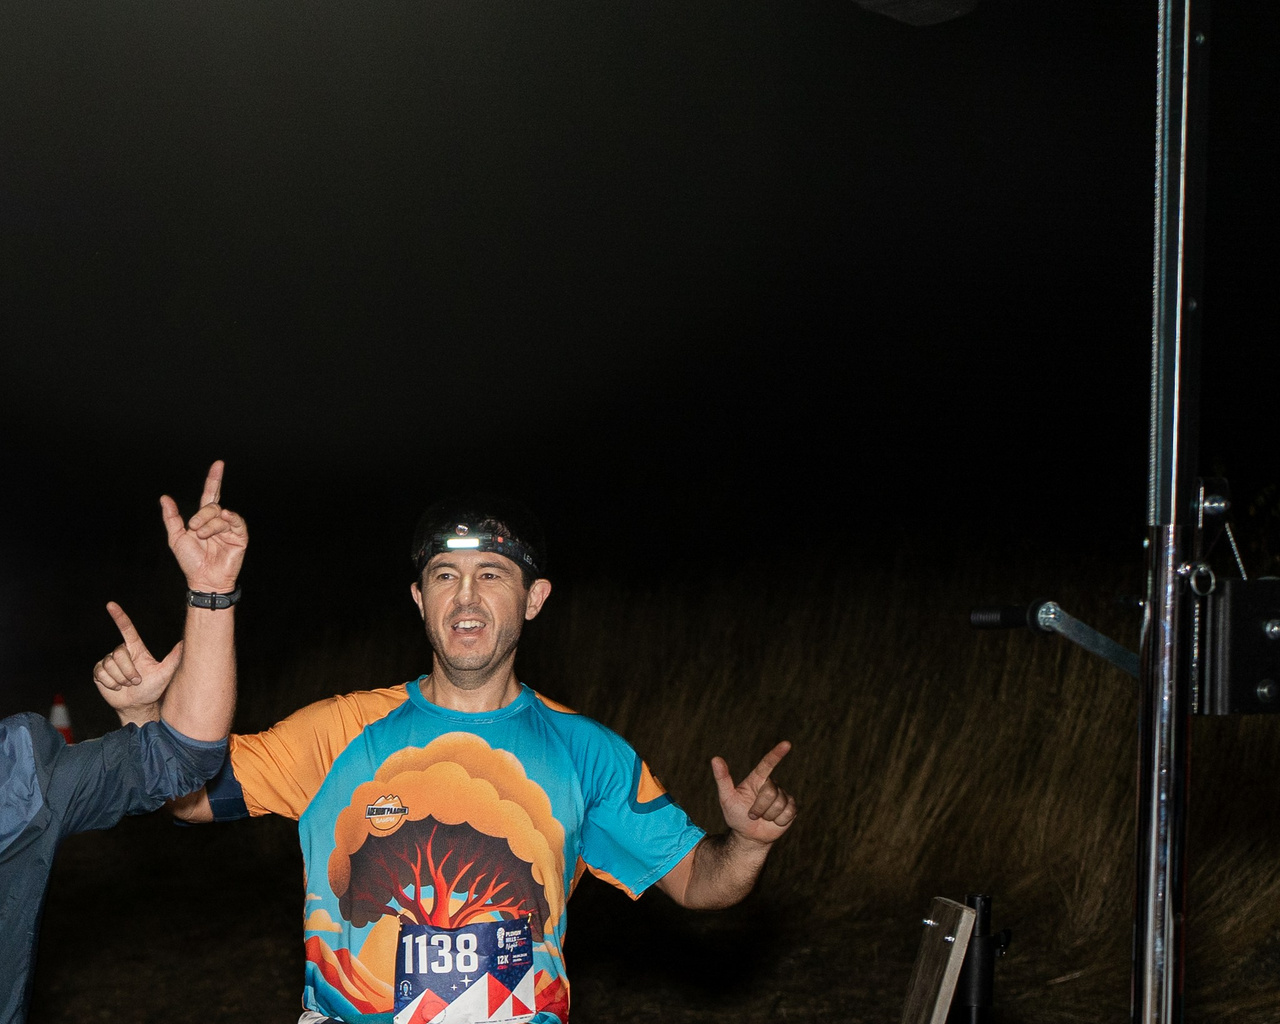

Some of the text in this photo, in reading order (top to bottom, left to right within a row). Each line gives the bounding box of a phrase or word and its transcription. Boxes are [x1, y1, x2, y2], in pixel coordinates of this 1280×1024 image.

[523, 553, 533, 566] LED
[402, 933, 479, 974] 1138
[497, 955, 509, 965] 12K
